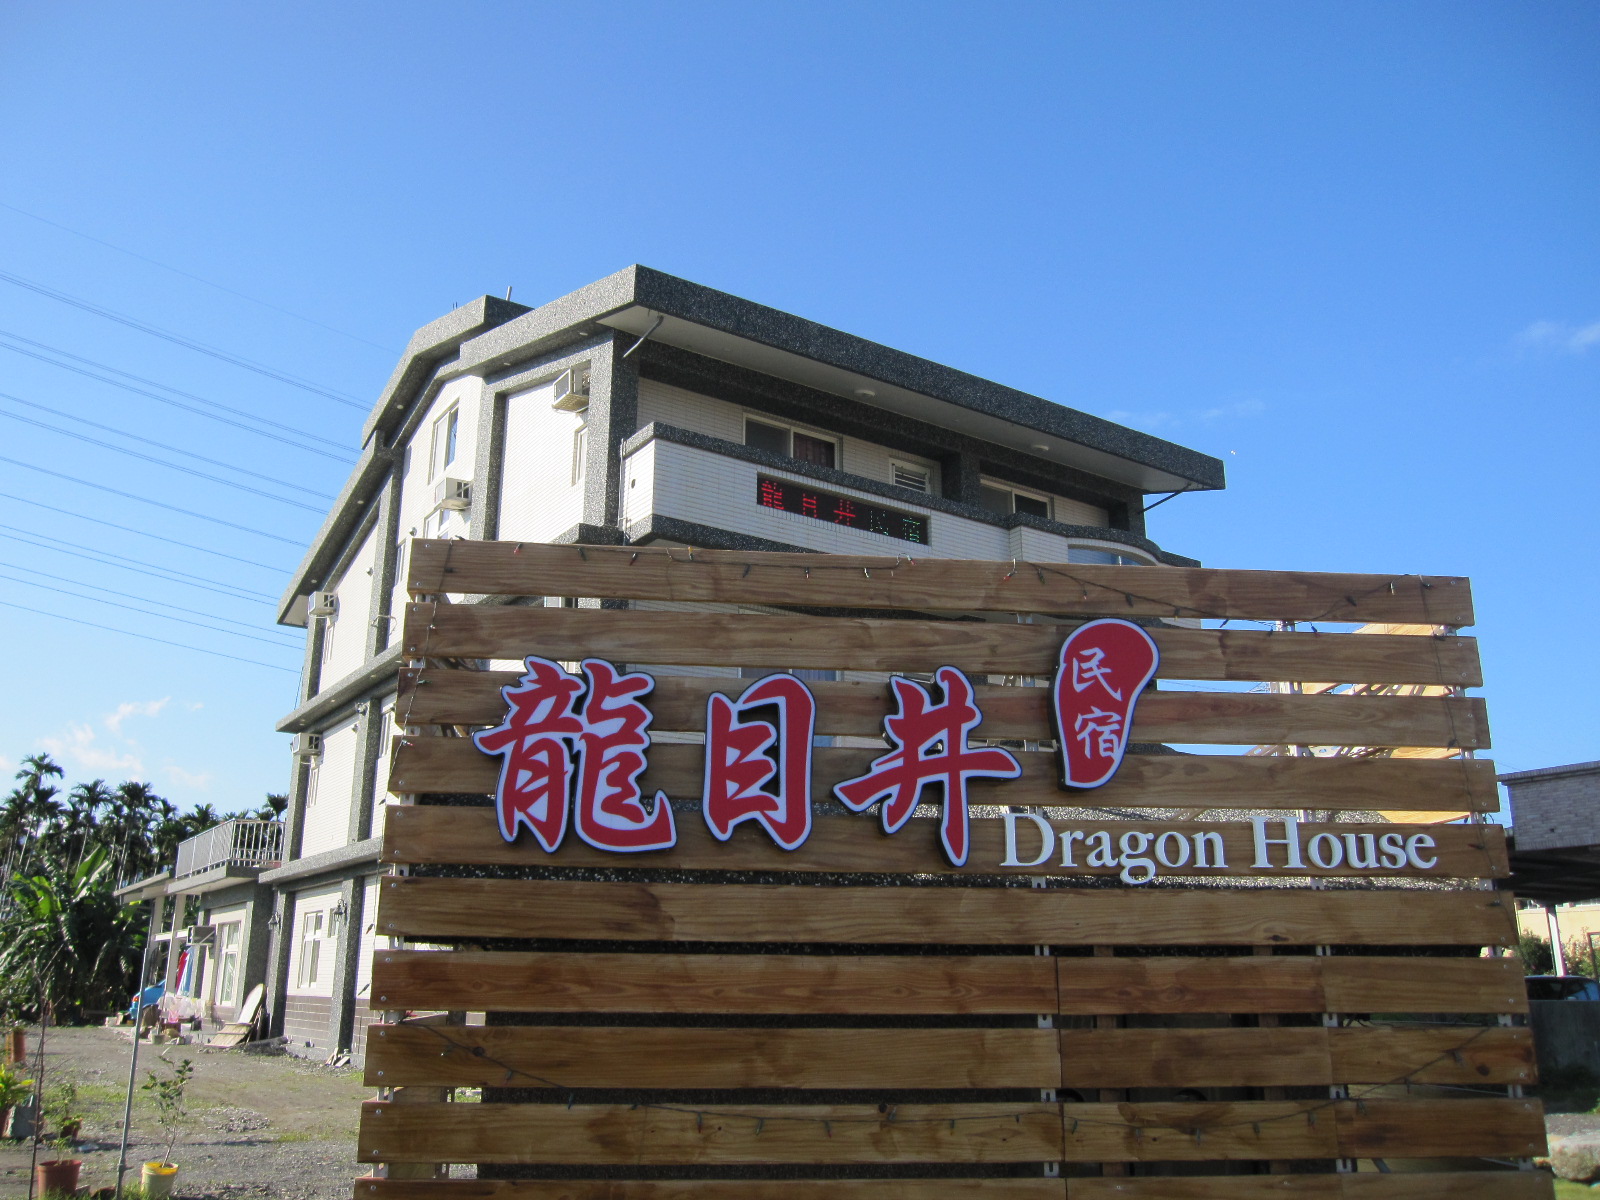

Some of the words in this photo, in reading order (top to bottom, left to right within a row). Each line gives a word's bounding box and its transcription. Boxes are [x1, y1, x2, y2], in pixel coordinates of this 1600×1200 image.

[473, 655, 1021, 867] 龍目井
[1071, 647, 1123, 761] 民宿
[1000, 812, 1229, 885] Dragon
[1250, 815, 1438, 870] House
